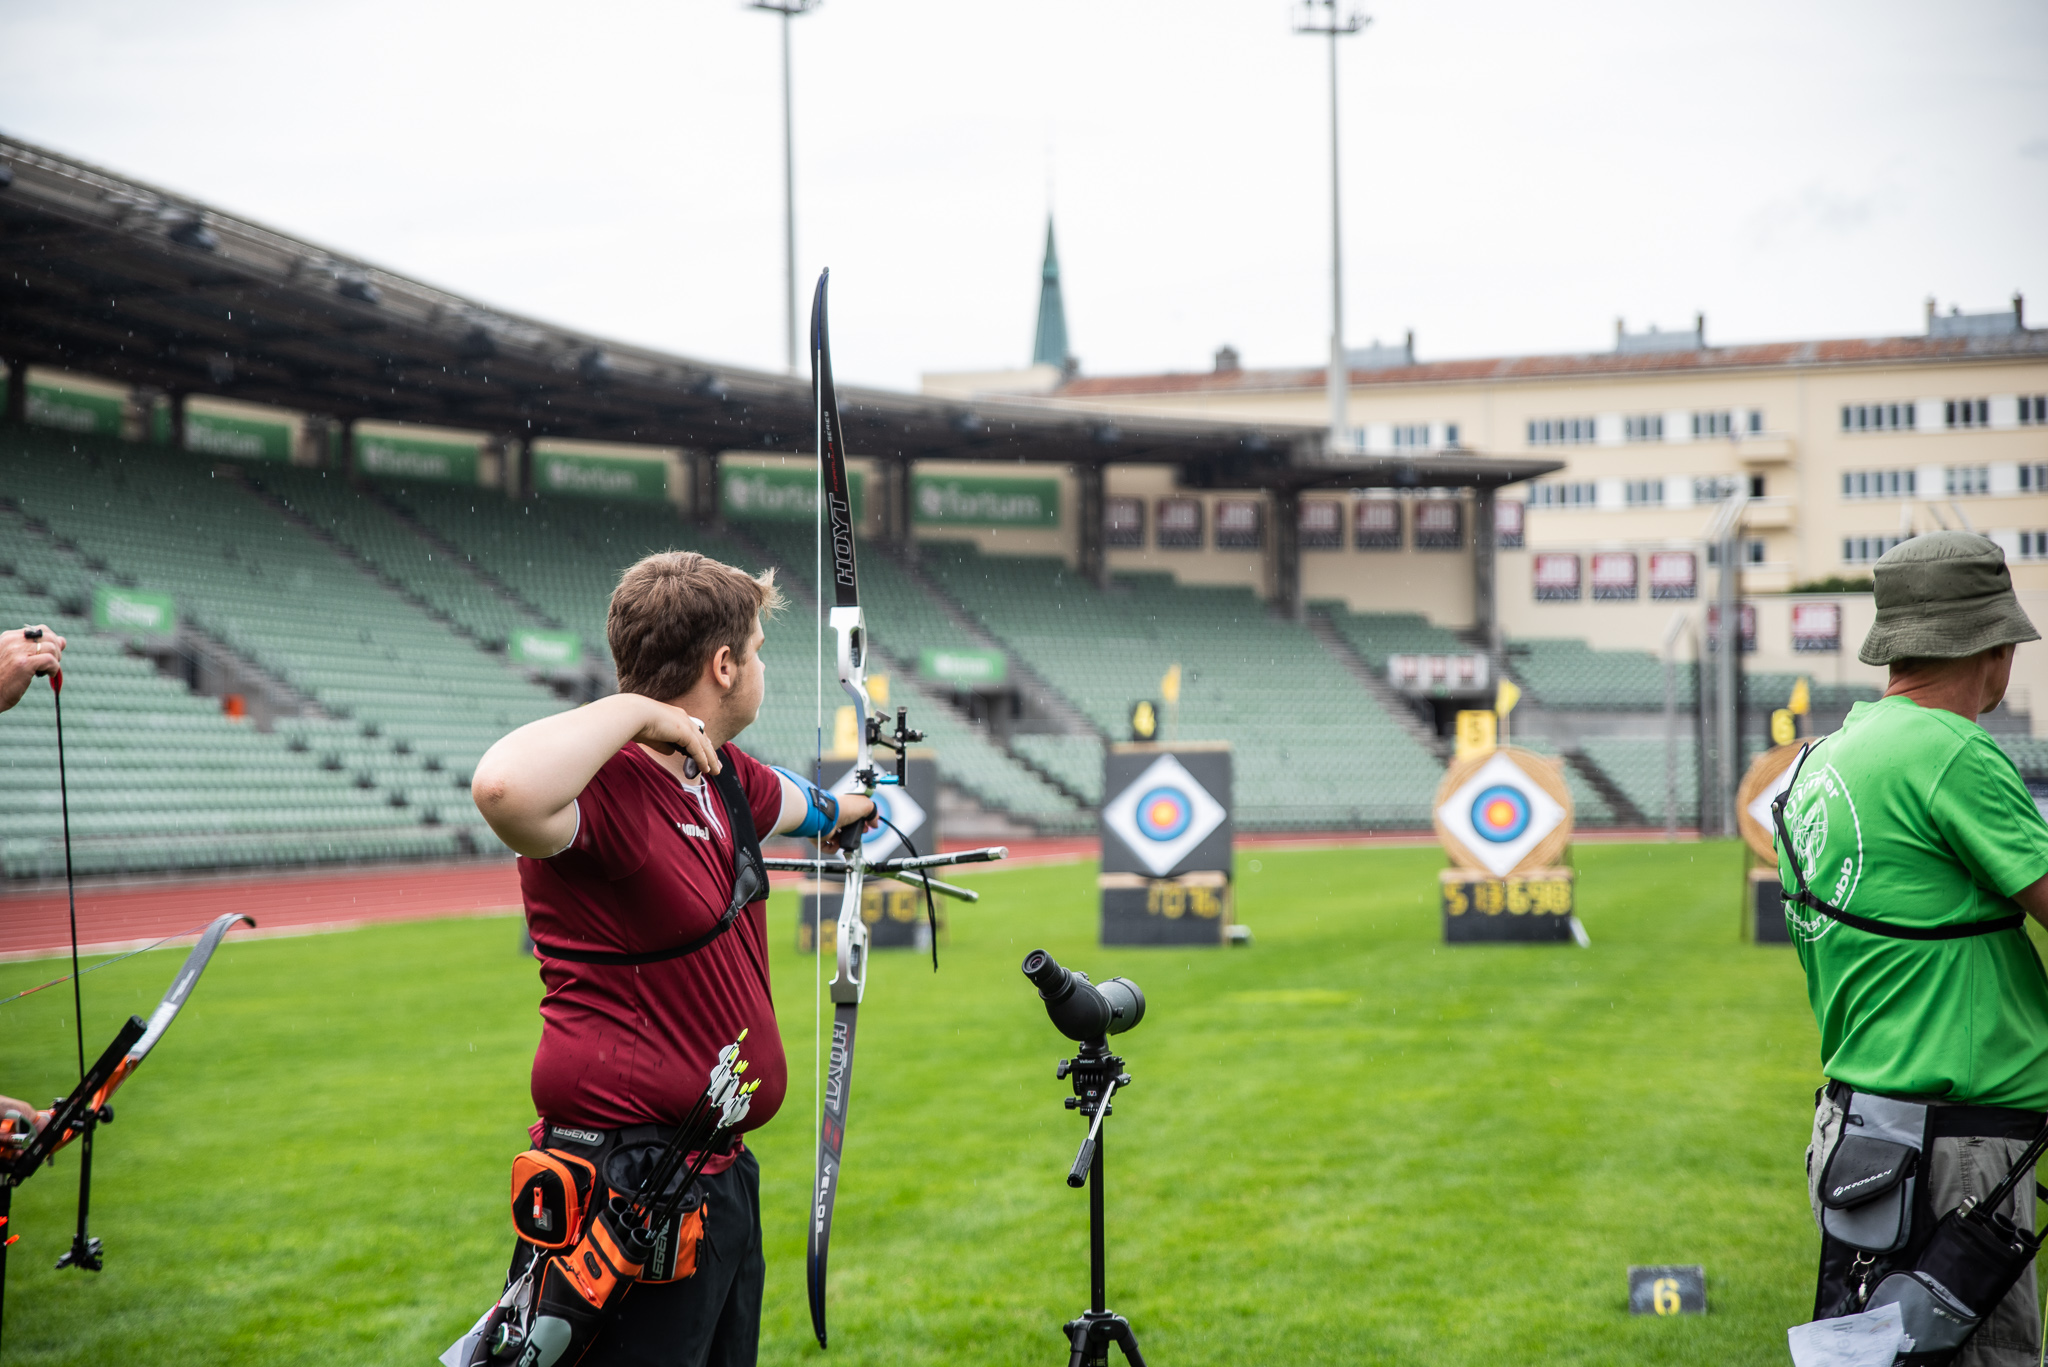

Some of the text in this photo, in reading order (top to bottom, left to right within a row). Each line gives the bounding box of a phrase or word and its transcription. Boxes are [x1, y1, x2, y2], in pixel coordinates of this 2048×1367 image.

[829, 492, 854, 586] HOYT
[825, 1020, 848, 1111] HOYT
[553, 1126, 599, 1142] LEGEND
[816, 1163, 832, 1234] VELOS
[1653, 1277, 1681, 1317] 6
